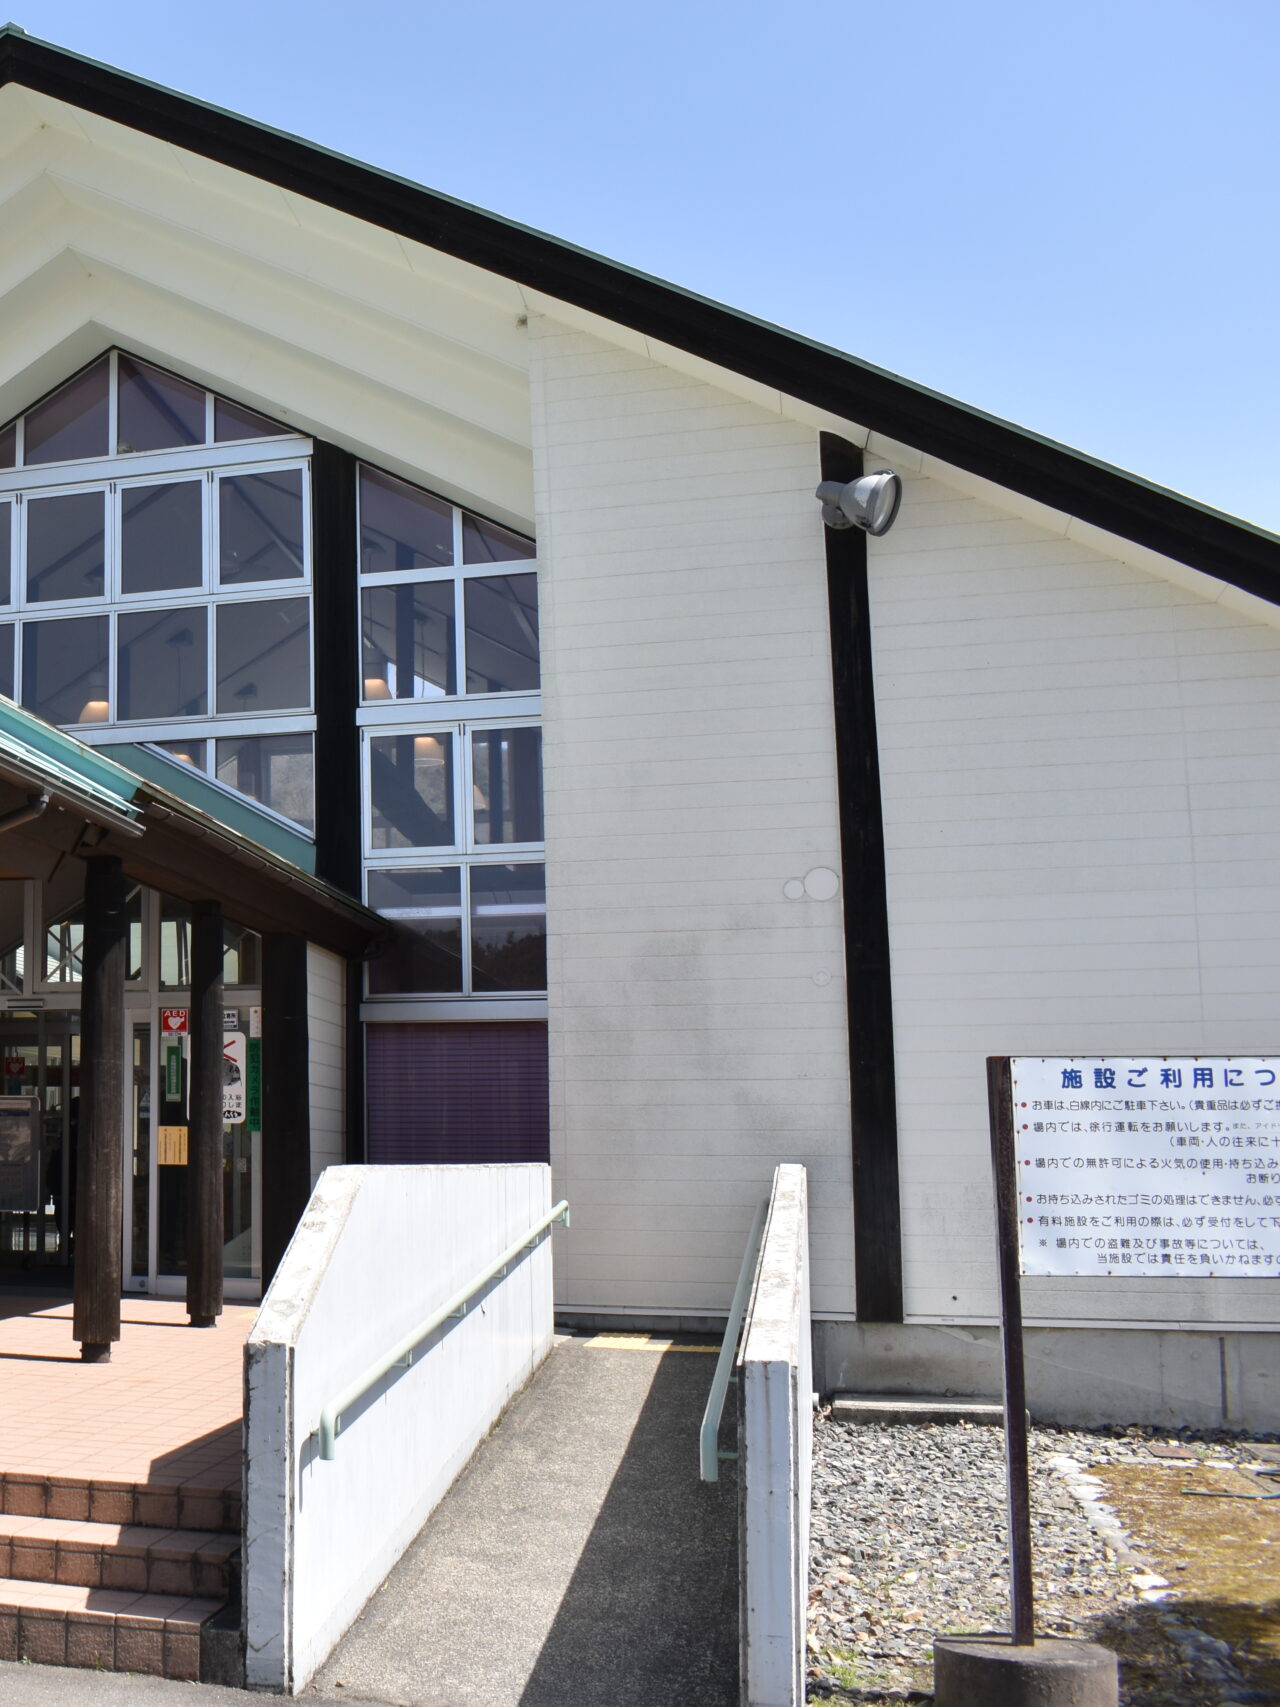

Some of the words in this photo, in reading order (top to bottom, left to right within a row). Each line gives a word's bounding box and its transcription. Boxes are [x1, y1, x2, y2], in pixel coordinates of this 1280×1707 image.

[1061, 1067, 1276, 1089] 施設ご利用につ
[1246, 1173, 1280, 1184] お断り
